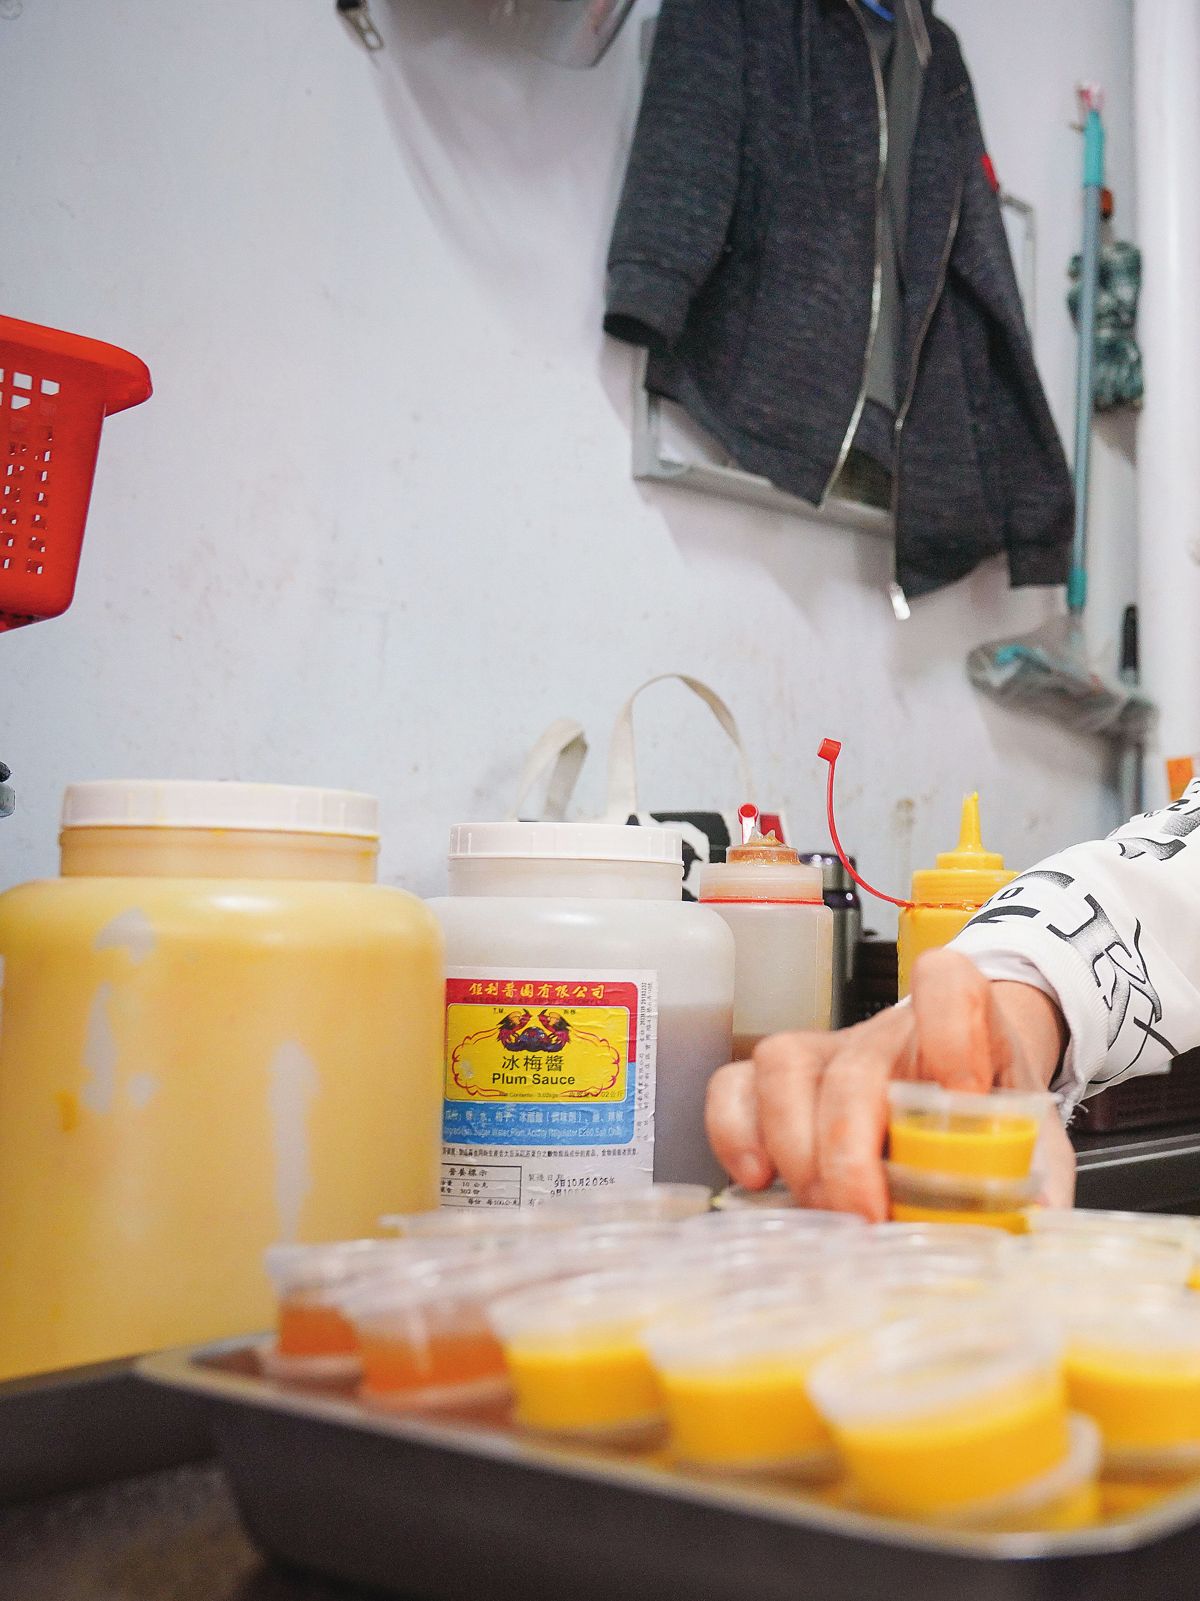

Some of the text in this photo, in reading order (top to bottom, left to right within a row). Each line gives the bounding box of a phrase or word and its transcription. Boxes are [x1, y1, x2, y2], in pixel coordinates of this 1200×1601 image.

[501, 1055, 564, 1072] 冰梅醬
[492, 1073, 576, 1085] Plum Sauce
